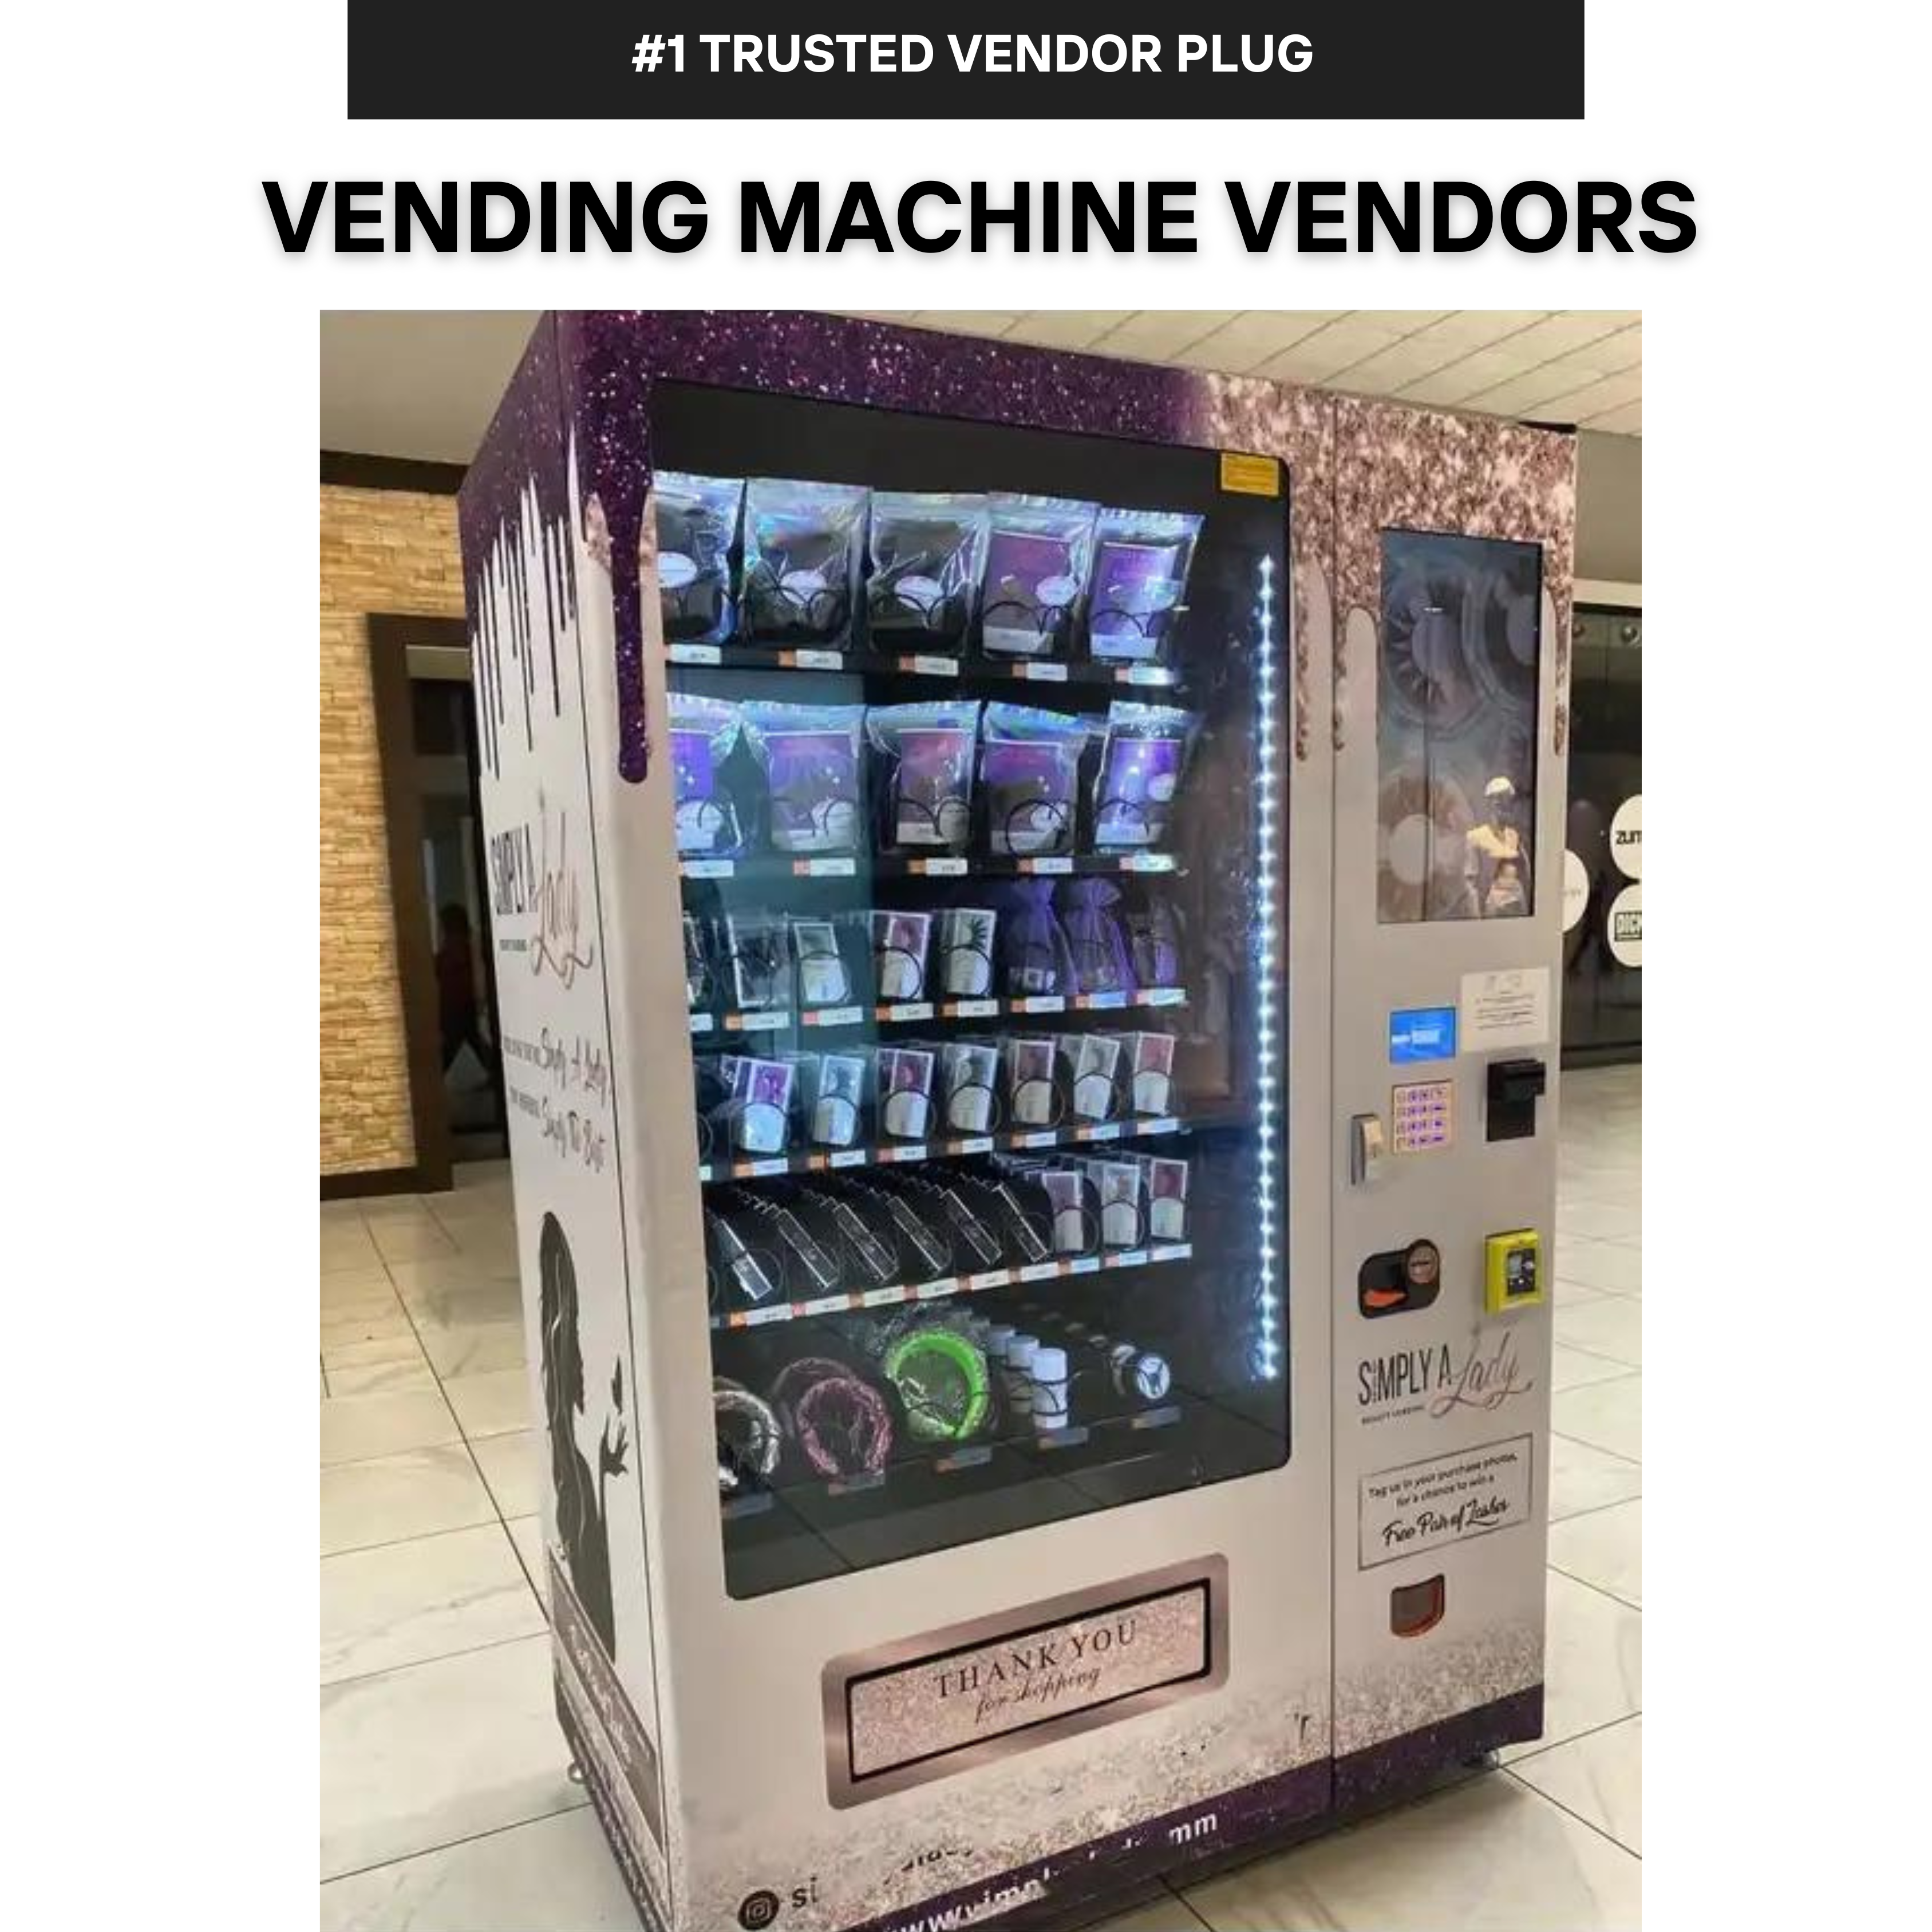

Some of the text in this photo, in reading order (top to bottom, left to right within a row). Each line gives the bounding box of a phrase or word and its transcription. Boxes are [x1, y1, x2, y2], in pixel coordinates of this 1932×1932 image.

[1368, 1485, 1387, 1498] Tag
[1414, 1472, 1436, 1488] your
[1396, 1496, 1411, 1508] for
[1383, 1520, 1415, 1547] Free
[933, 1619, 1136, 1698] THANK YOU
[974, 1667, 1101, 1723] for shopping
